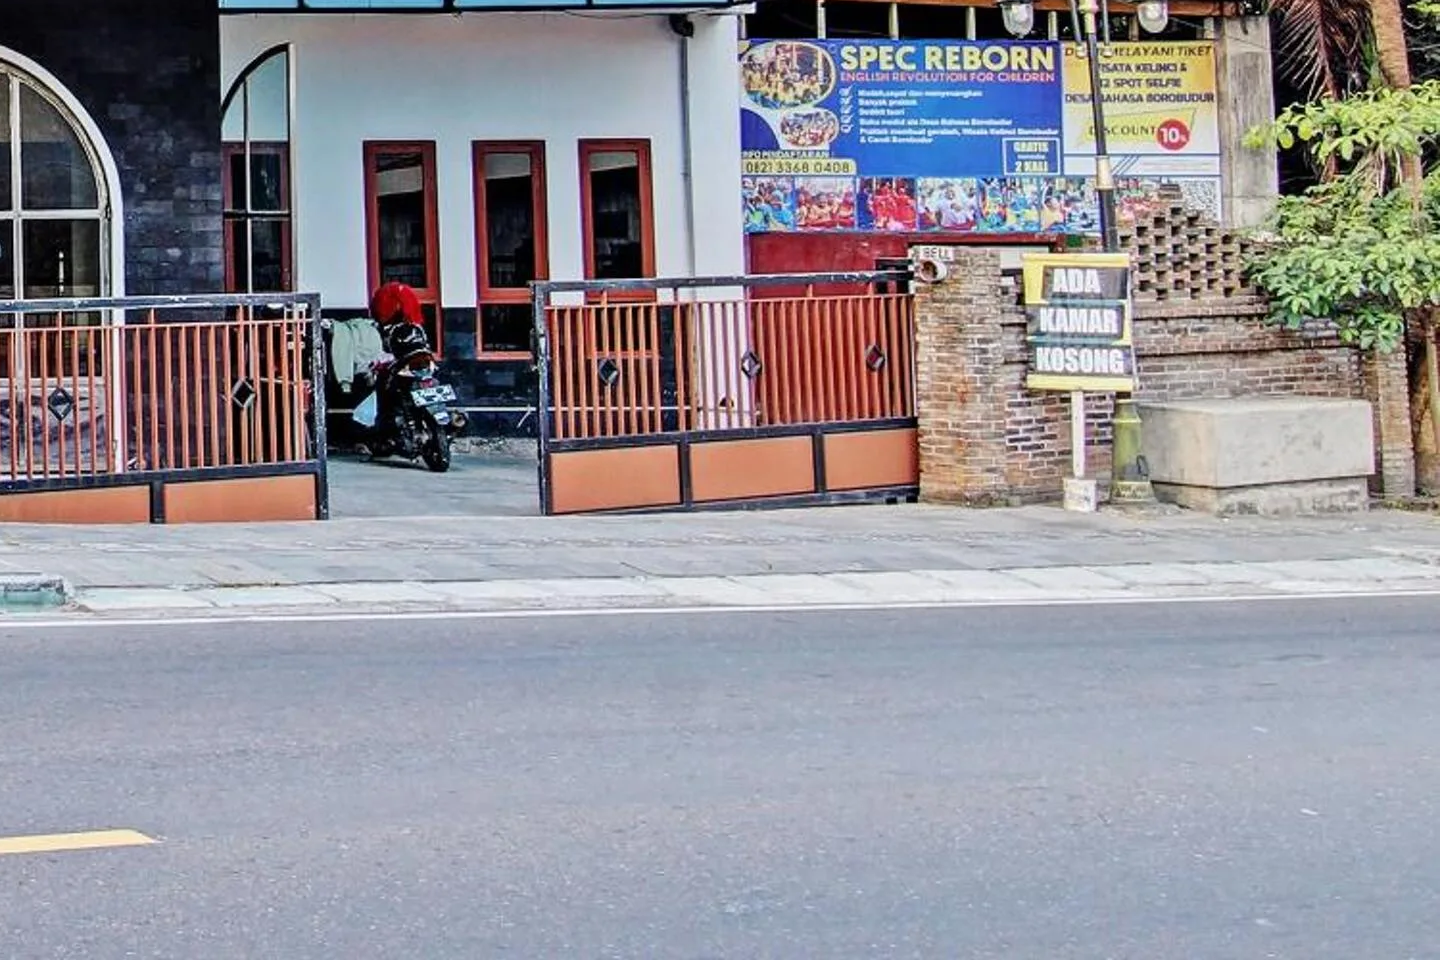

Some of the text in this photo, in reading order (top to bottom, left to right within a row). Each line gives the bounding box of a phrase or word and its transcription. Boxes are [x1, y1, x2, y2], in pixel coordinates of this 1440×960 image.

[840, 45, 917, 71] SPEC
[924, 45, 1055, 72] REBORN
[1098, 63, 1132, 73] ISATA
[1135, 63, 1177, 73] KELINCI
[840, 72, 1055, 82] ENGLISH REVOLUTION FOR CHILDREN
[1113, 78, 1142, 88] SPOT
[1145, 78, 1182, 88] SELFIE
[1146, 92, 1215, 103] BOROBUDUR
[1089, 124, 1157, 136] DSCOUNT
[746, 160, 850, 174] 0821 3368 0408
[1053, 268, 1101, 293] ADA
[1040, 308, 1118, 334] KAMAR
[1036, 346, 1125, 373] KOSONG
